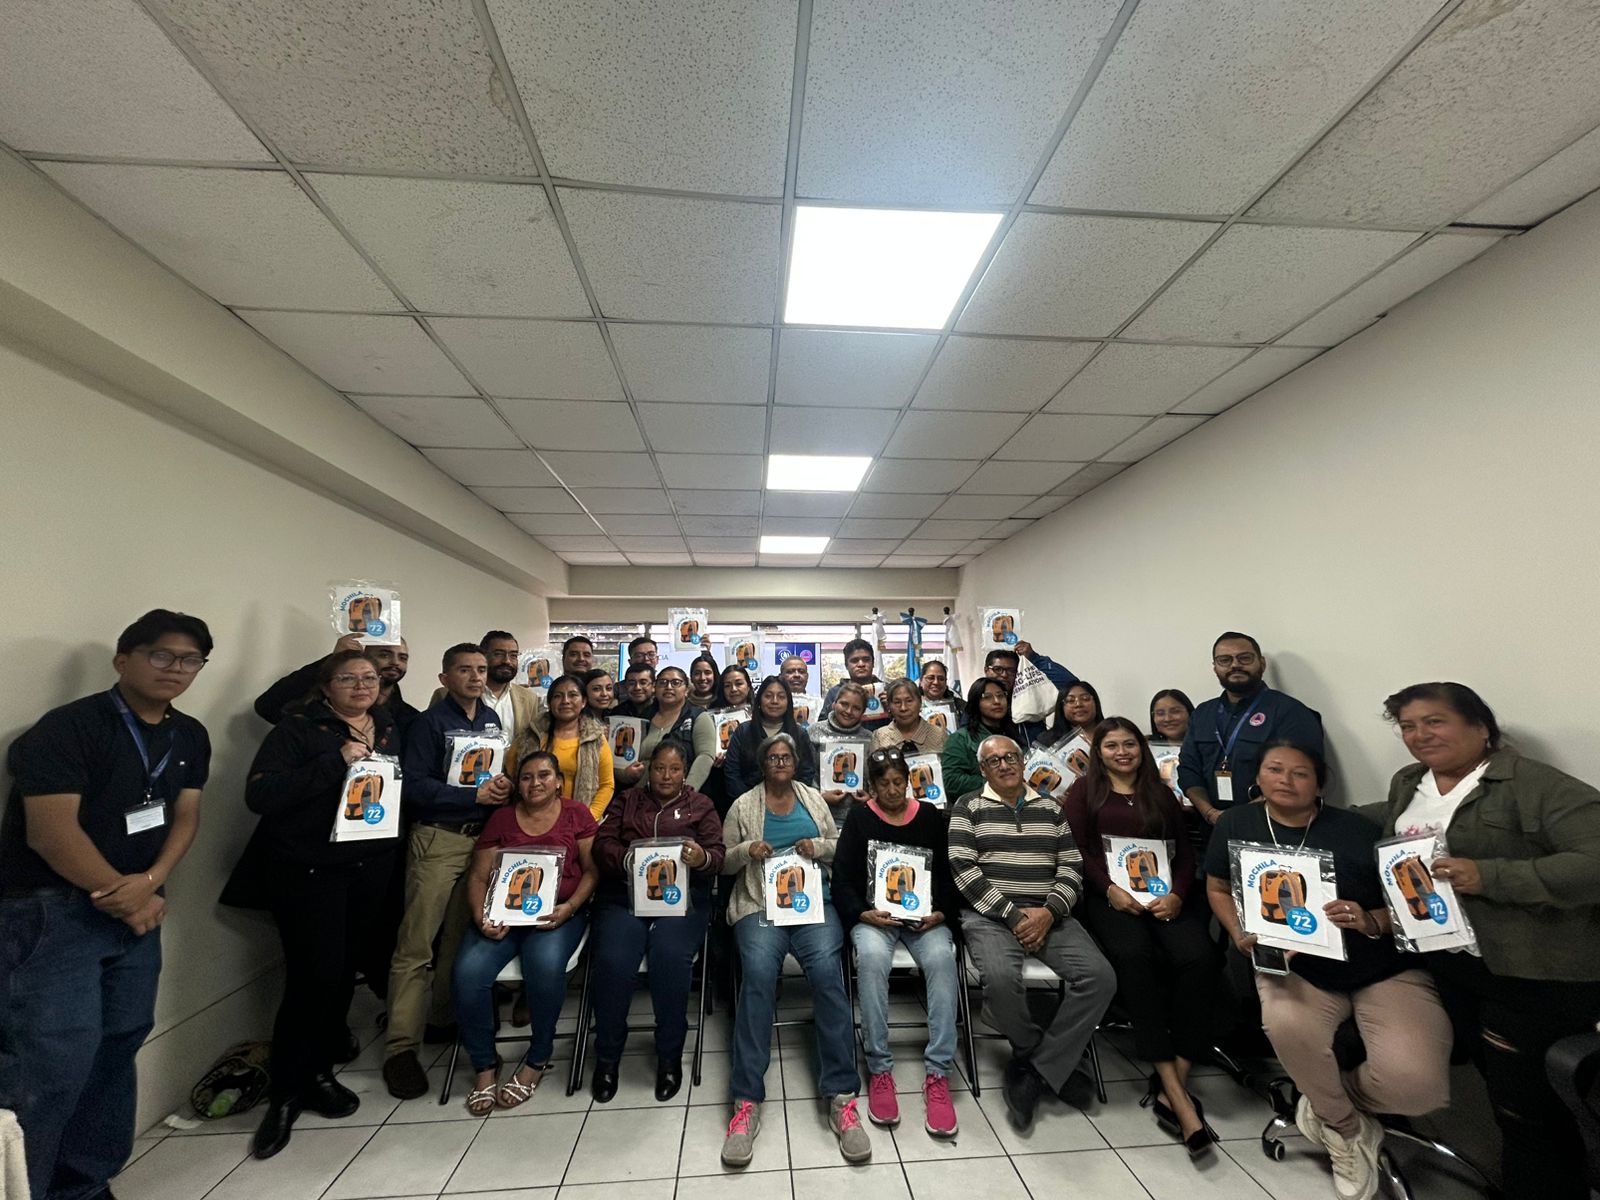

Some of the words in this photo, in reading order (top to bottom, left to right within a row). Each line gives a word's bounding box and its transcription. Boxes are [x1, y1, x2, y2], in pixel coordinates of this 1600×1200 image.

[369, 624, 383, 632] 72
[1028, 760, 1053, 771] MOCHILA
[367, 810, 381, 819] 72
[1117, 843, 1137, 868] MOCHILA
[638, 852, 659, 877] MOCHILA
[878, 857, 900, 879] MOCHILA
[1385, 849, 1406, 887] MOCHILA
[501, 859, 528, 884] MOCHILA
[1247, 859, 1278, 888] MOCHILA
[1150, 883, 1165, 892] 72
[665, 890, 678, 899] 72
[525, 900, 539, 910] 72
[795, 898, 807, 907] 72
[905, 897, 916, 906] 72
[1430, 901, 1446, 916] 72
[1291, 914, 1312, 929] 72
